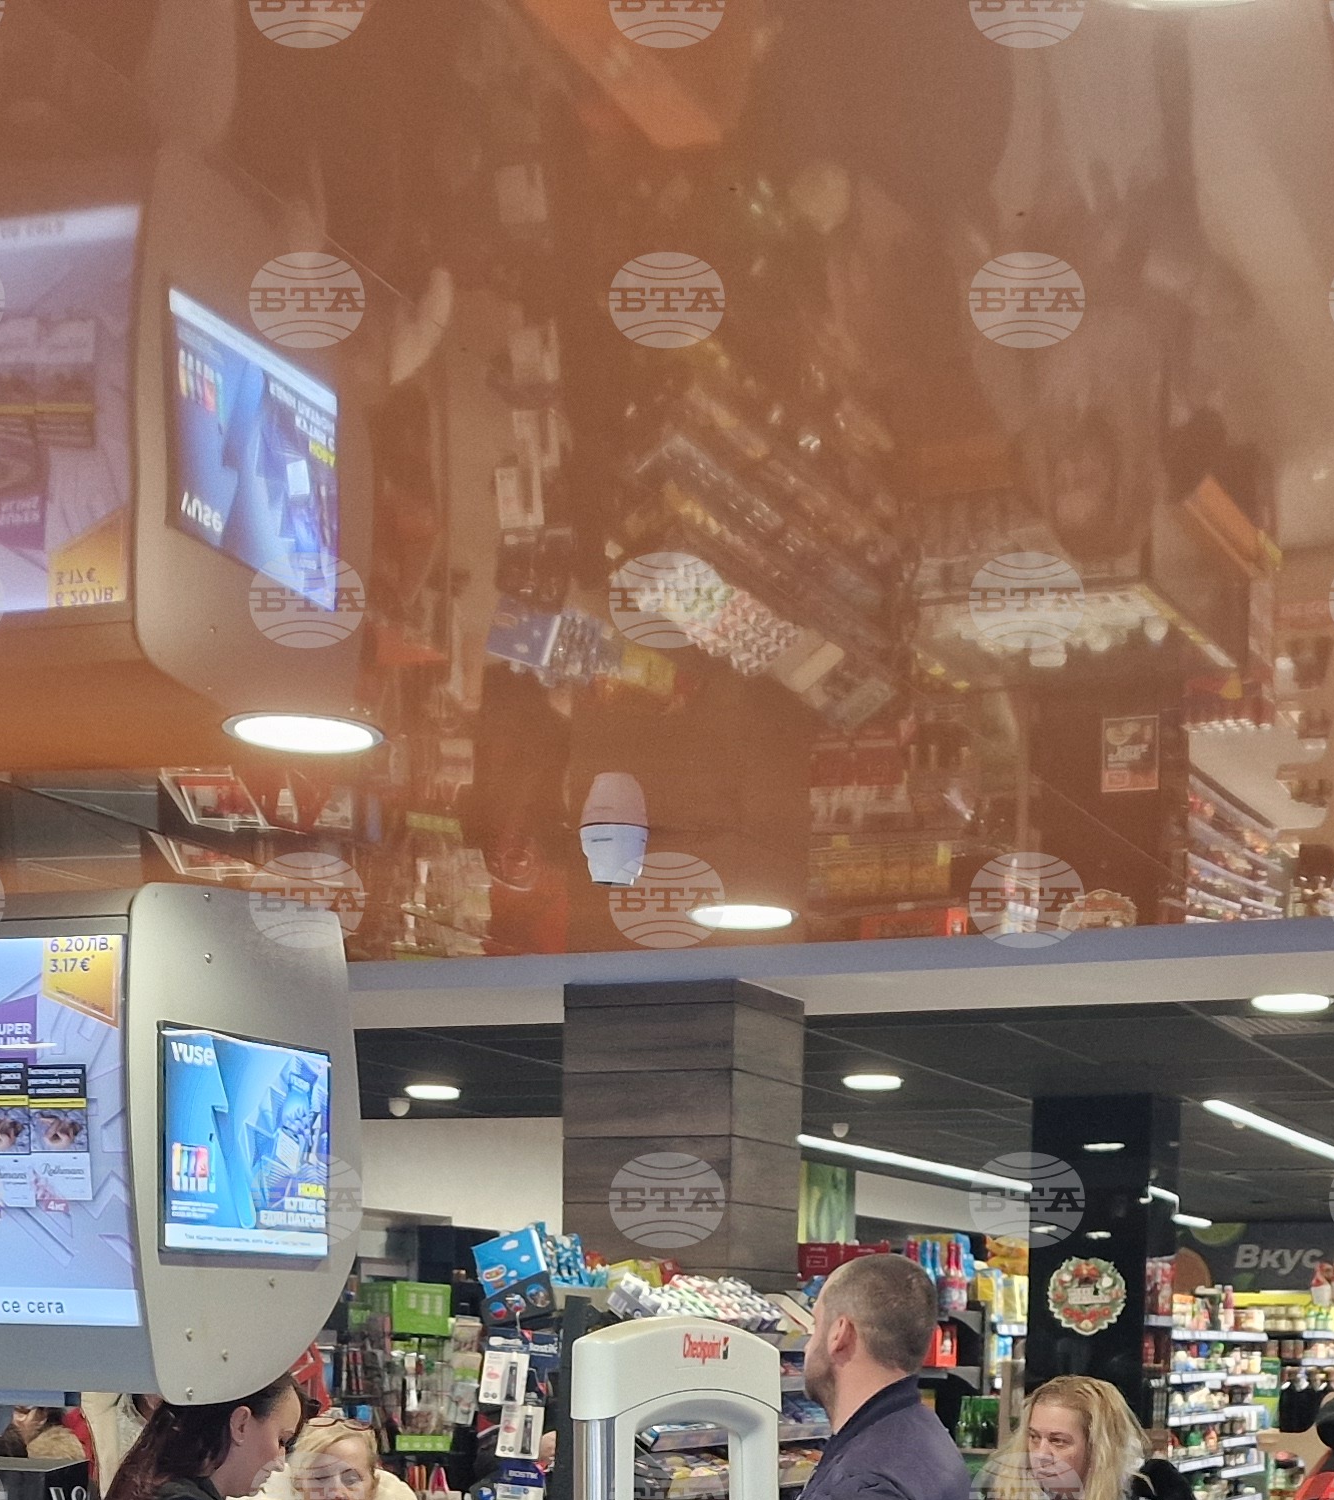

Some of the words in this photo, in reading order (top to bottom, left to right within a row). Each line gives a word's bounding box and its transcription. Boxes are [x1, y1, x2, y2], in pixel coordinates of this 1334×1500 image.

[1234, 1244, 1324, 1277] Вкус
[1, 1302, 22, 1314] се
[26, 1302, 66, 1319] сега
[683, 1332, 722, 1366] Checkpoint
